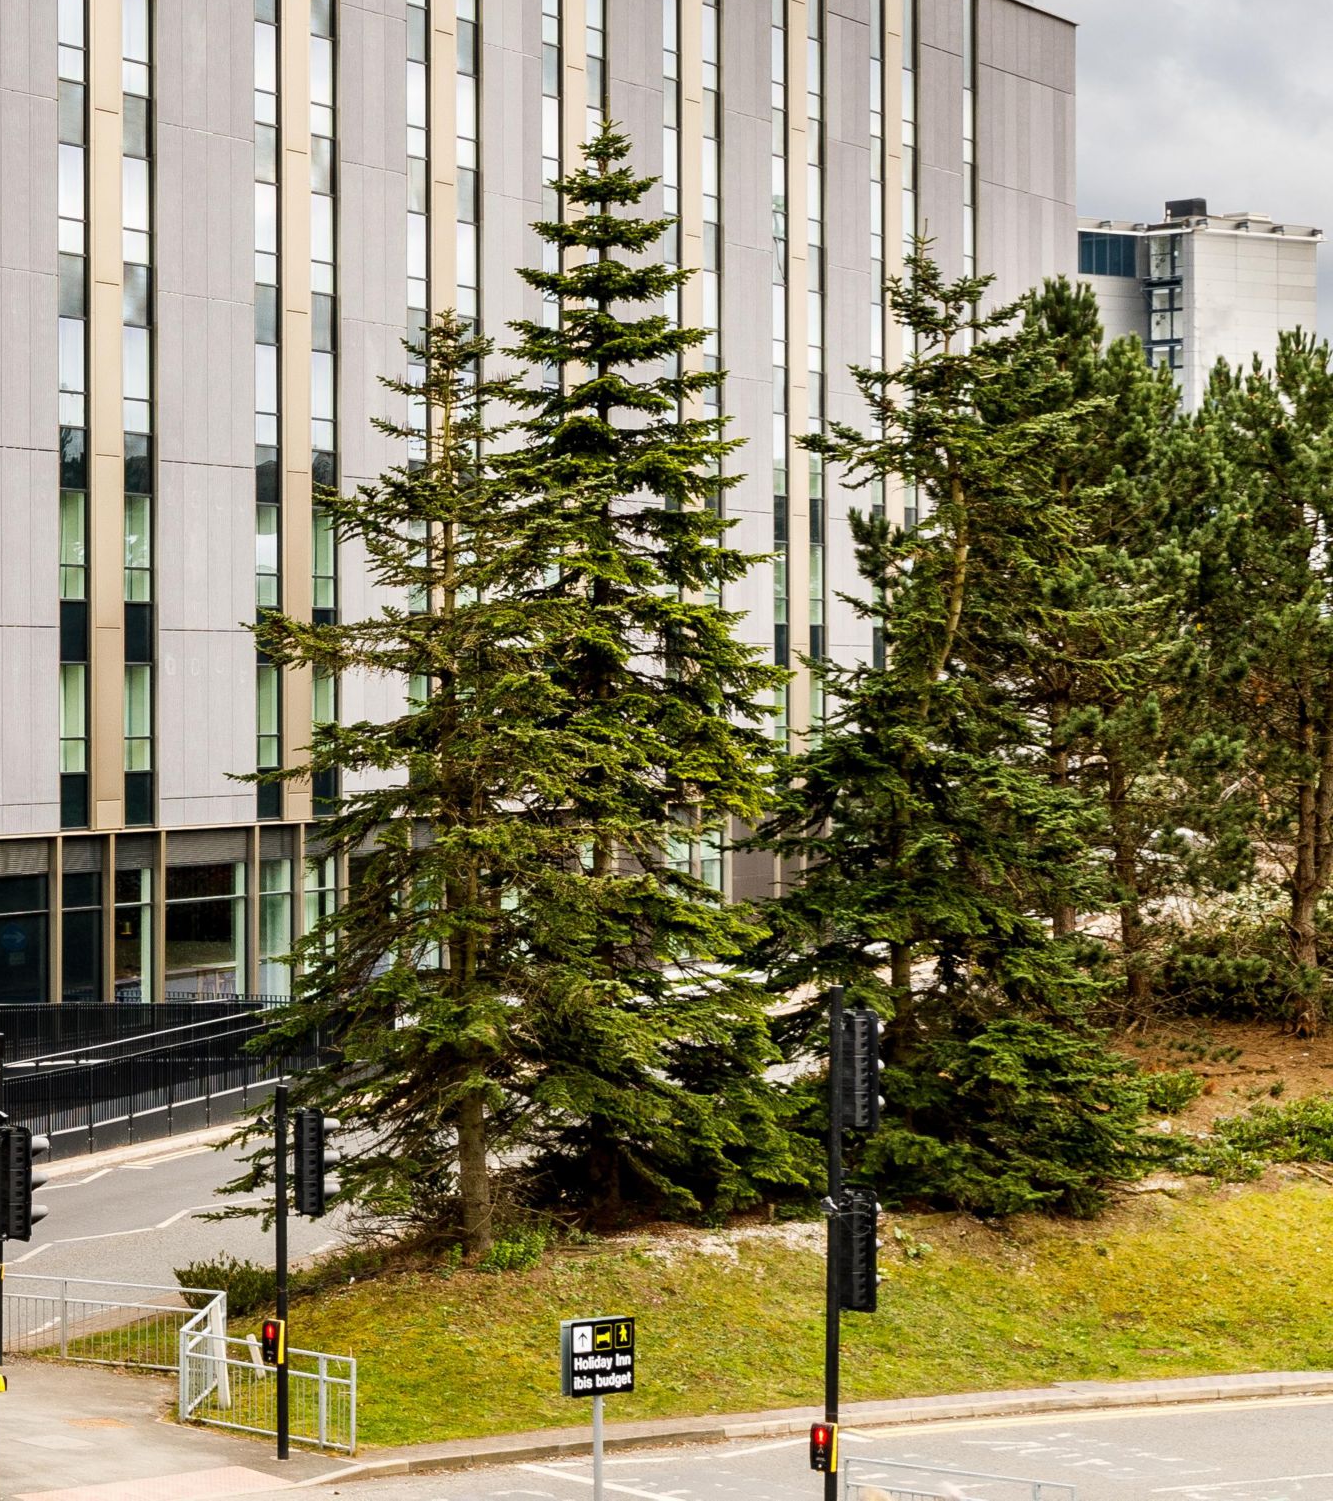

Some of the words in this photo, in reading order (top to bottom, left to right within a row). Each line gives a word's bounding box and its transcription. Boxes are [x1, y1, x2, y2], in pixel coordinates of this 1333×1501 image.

[573, 1356, 613, 1371] Holiday
[615, 1353, 632, 1367] Inn
[573, 1376, 593, 1390] ibis
[595, 1372, 632, 1389] budget
